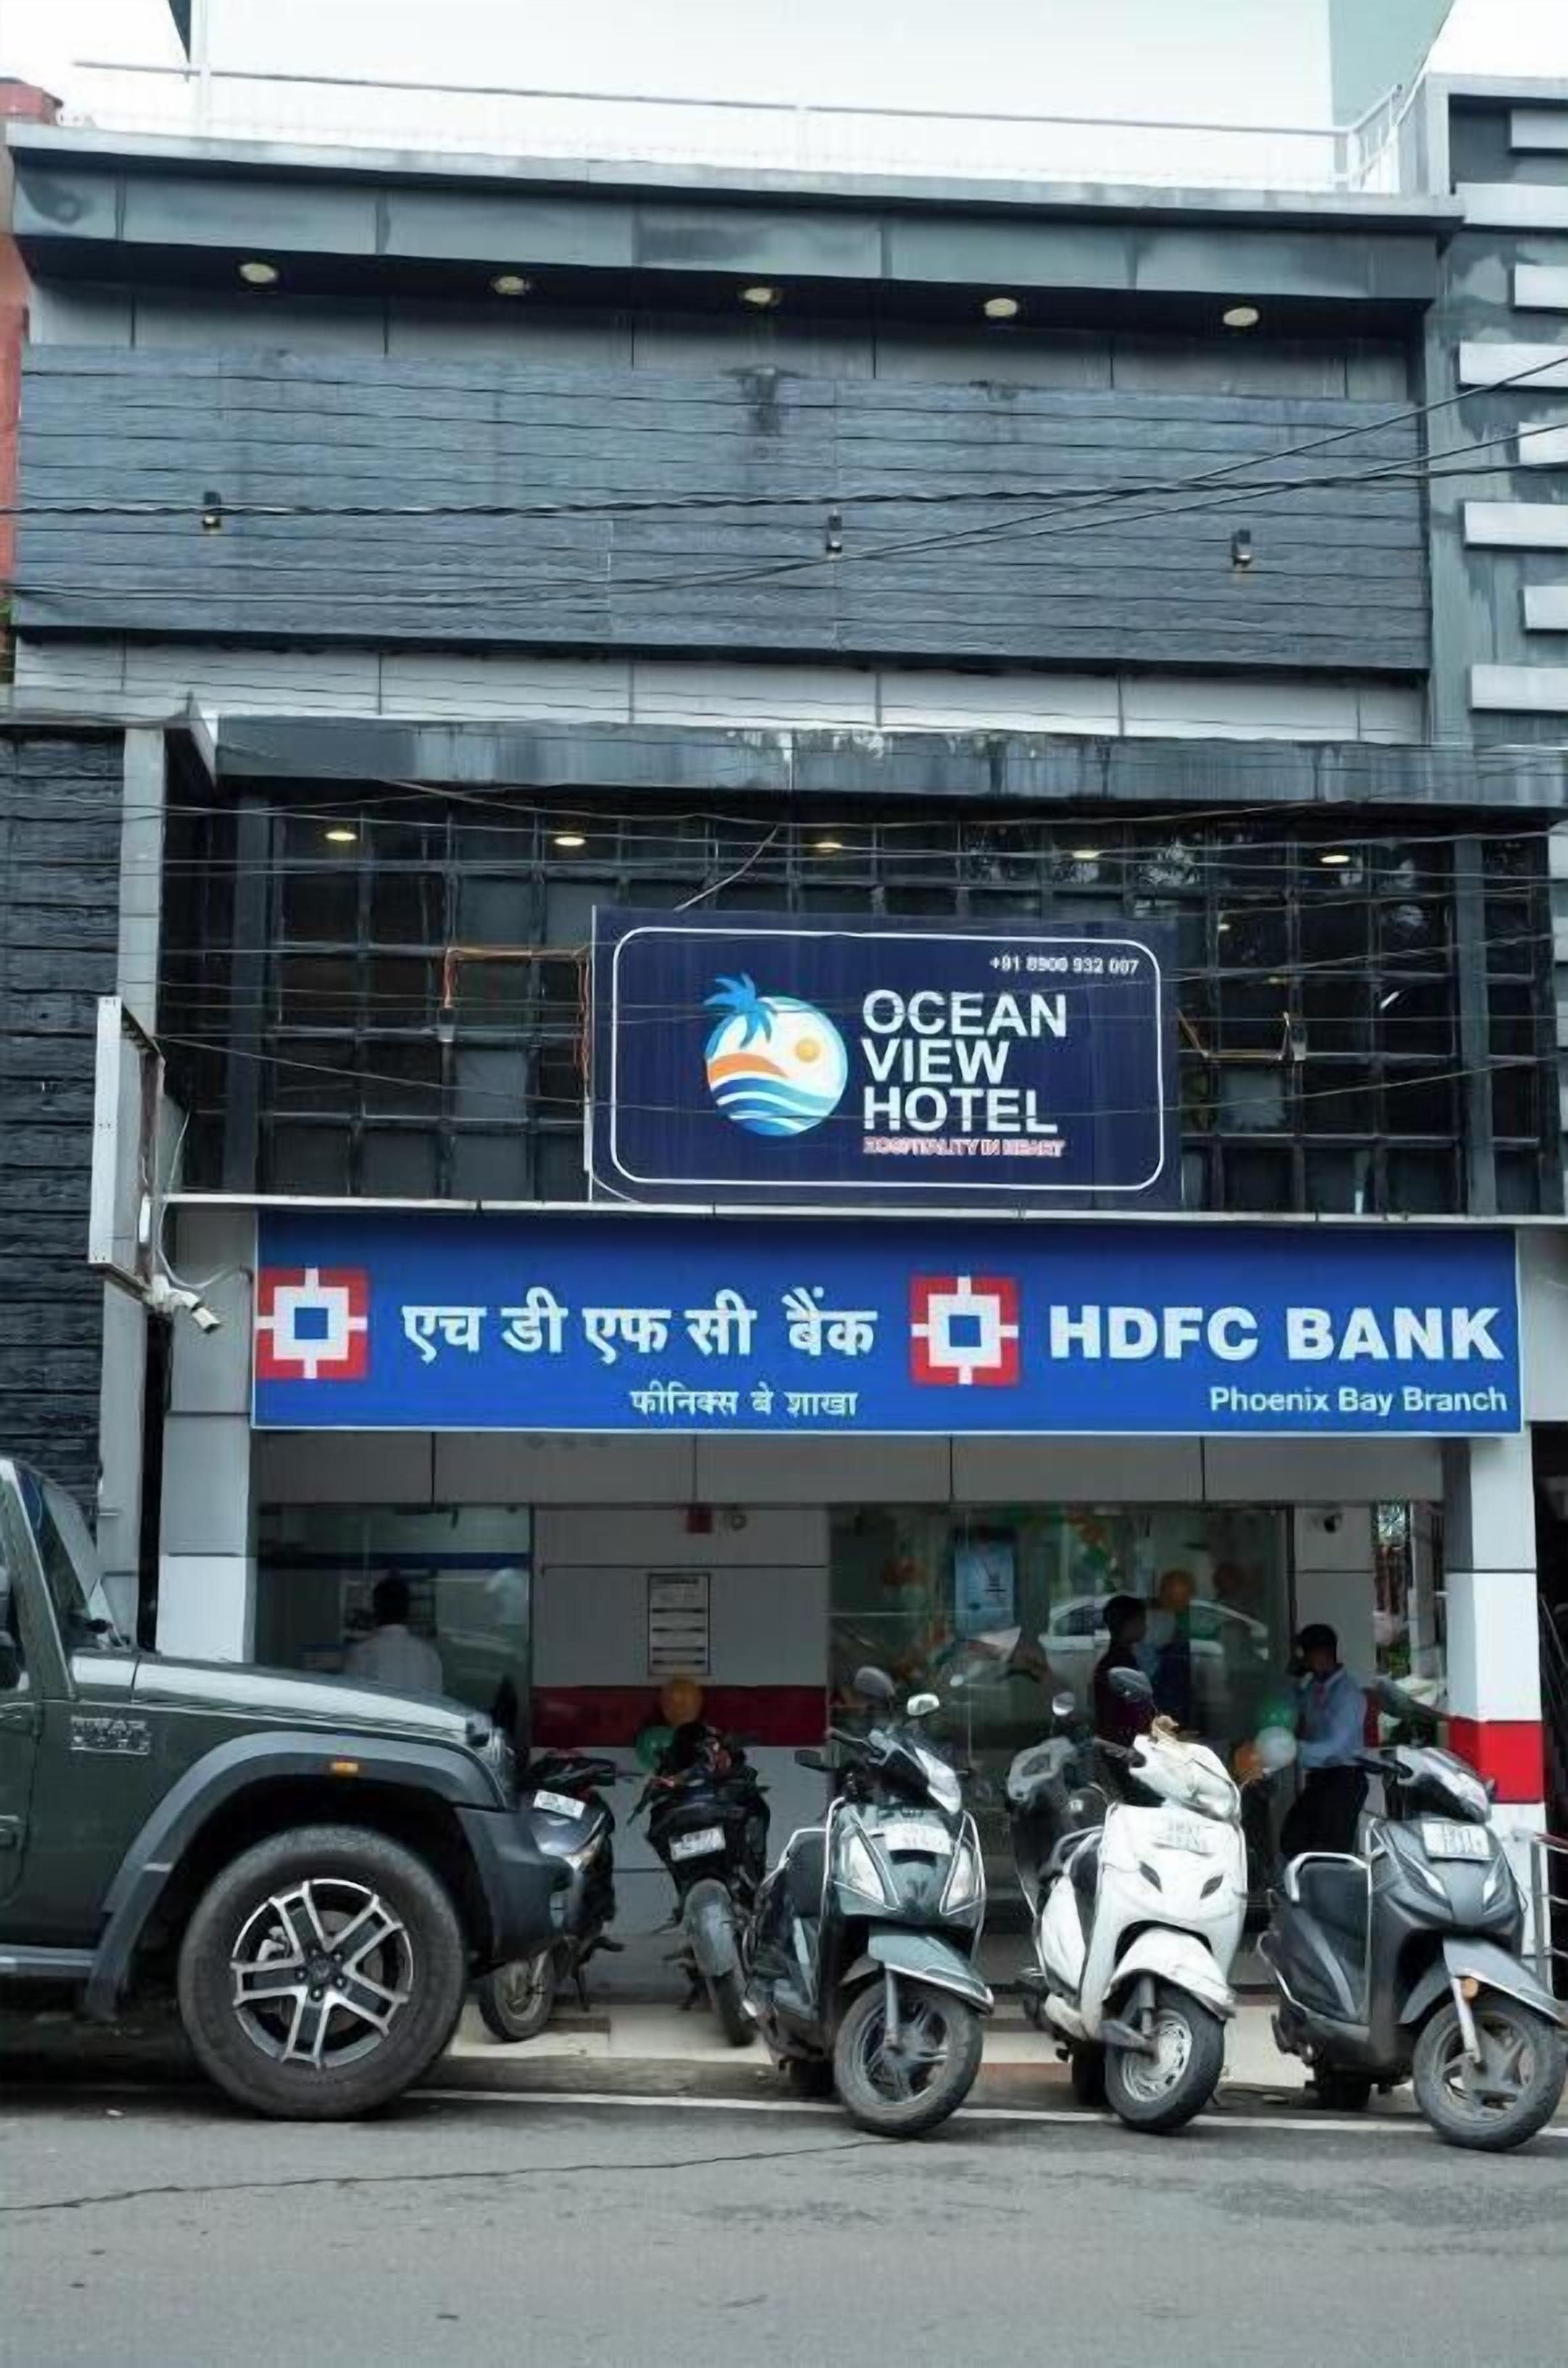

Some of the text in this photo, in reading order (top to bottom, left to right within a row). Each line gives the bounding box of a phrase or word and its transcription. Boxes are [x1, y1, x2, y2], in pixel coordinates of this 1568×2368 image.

[862, 989, 1066, 1037] OCEAN
[861, 1037, 1010, 1084] VIEW
[863, 1086, 1058, 1133] HOTEL
[402, 1287, 878, 1364] एच डी एफ सी बैंक
[1050, 1305, 1505, 1360] HDFC BANK
[785, 1391, 858, 1416] शाखा
[1210, 1386, 1507, 1417] Phoenix Bay Branch
